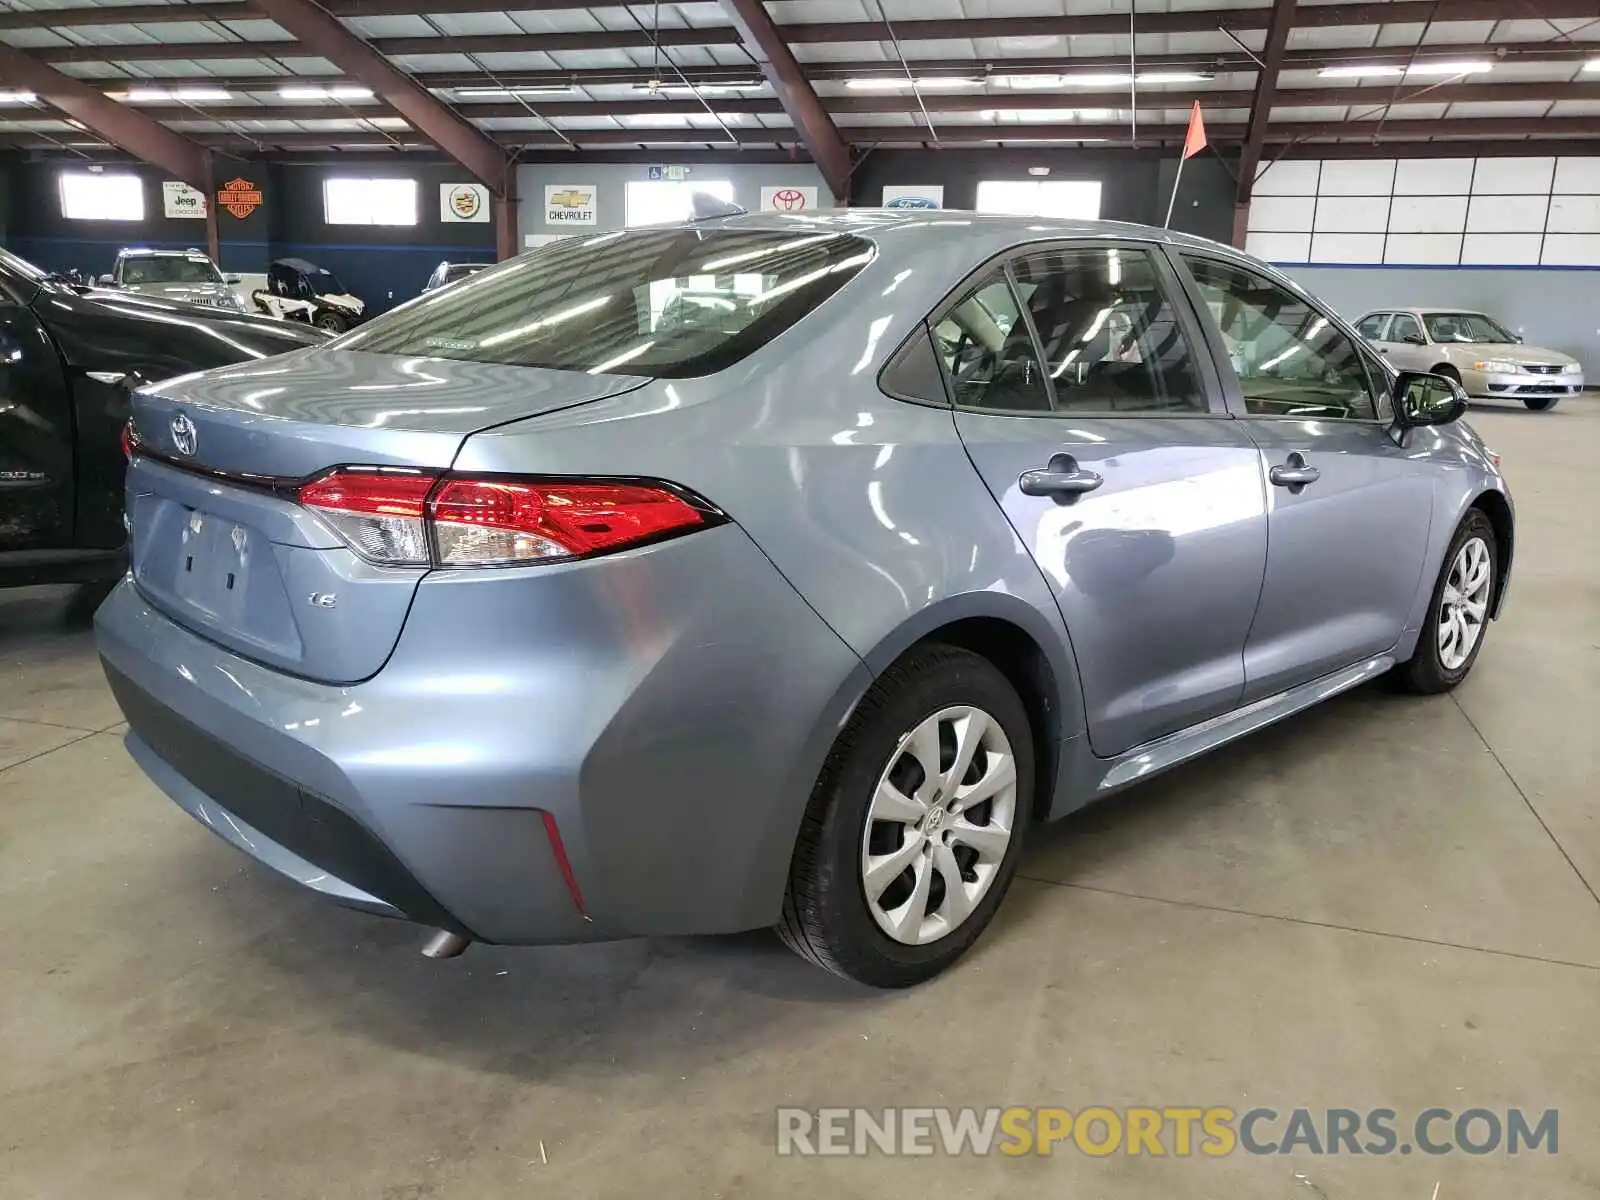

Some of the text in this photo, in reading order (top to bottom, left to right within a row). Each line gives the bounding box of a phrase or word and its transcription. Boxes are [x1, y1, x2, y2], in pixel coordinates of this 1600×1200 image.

[175, 195, 197, 206] Jeep
[549, 211, 592, 220] CHEVROLET
[308, 592, 337, 608] LE
